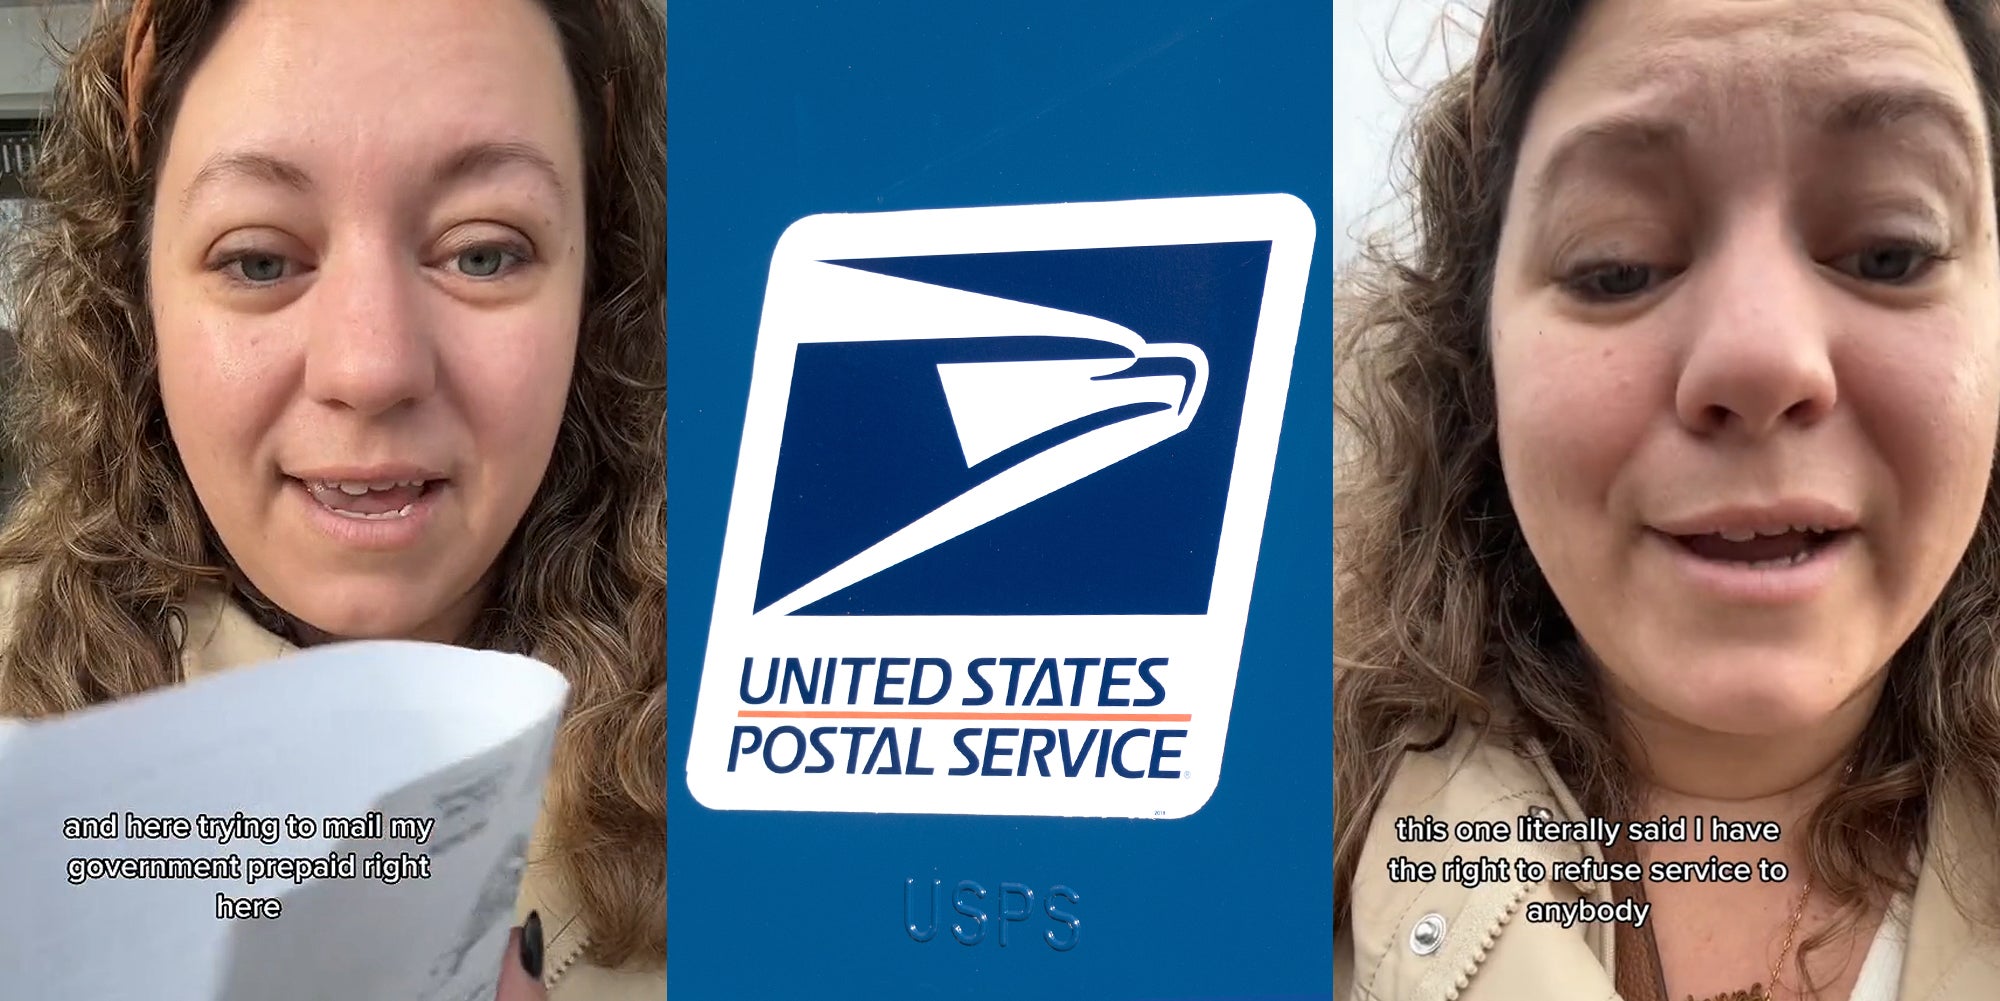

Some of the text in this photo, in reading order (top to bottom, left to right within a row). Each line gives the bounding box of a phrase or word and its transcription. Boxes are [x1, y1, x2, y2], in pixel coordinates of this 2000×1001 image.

[739, 657, 1169, 707] UNITED STATES
[727, 726, 935, 775] POSTAL
[904, 877, 1080, 952] USPS
